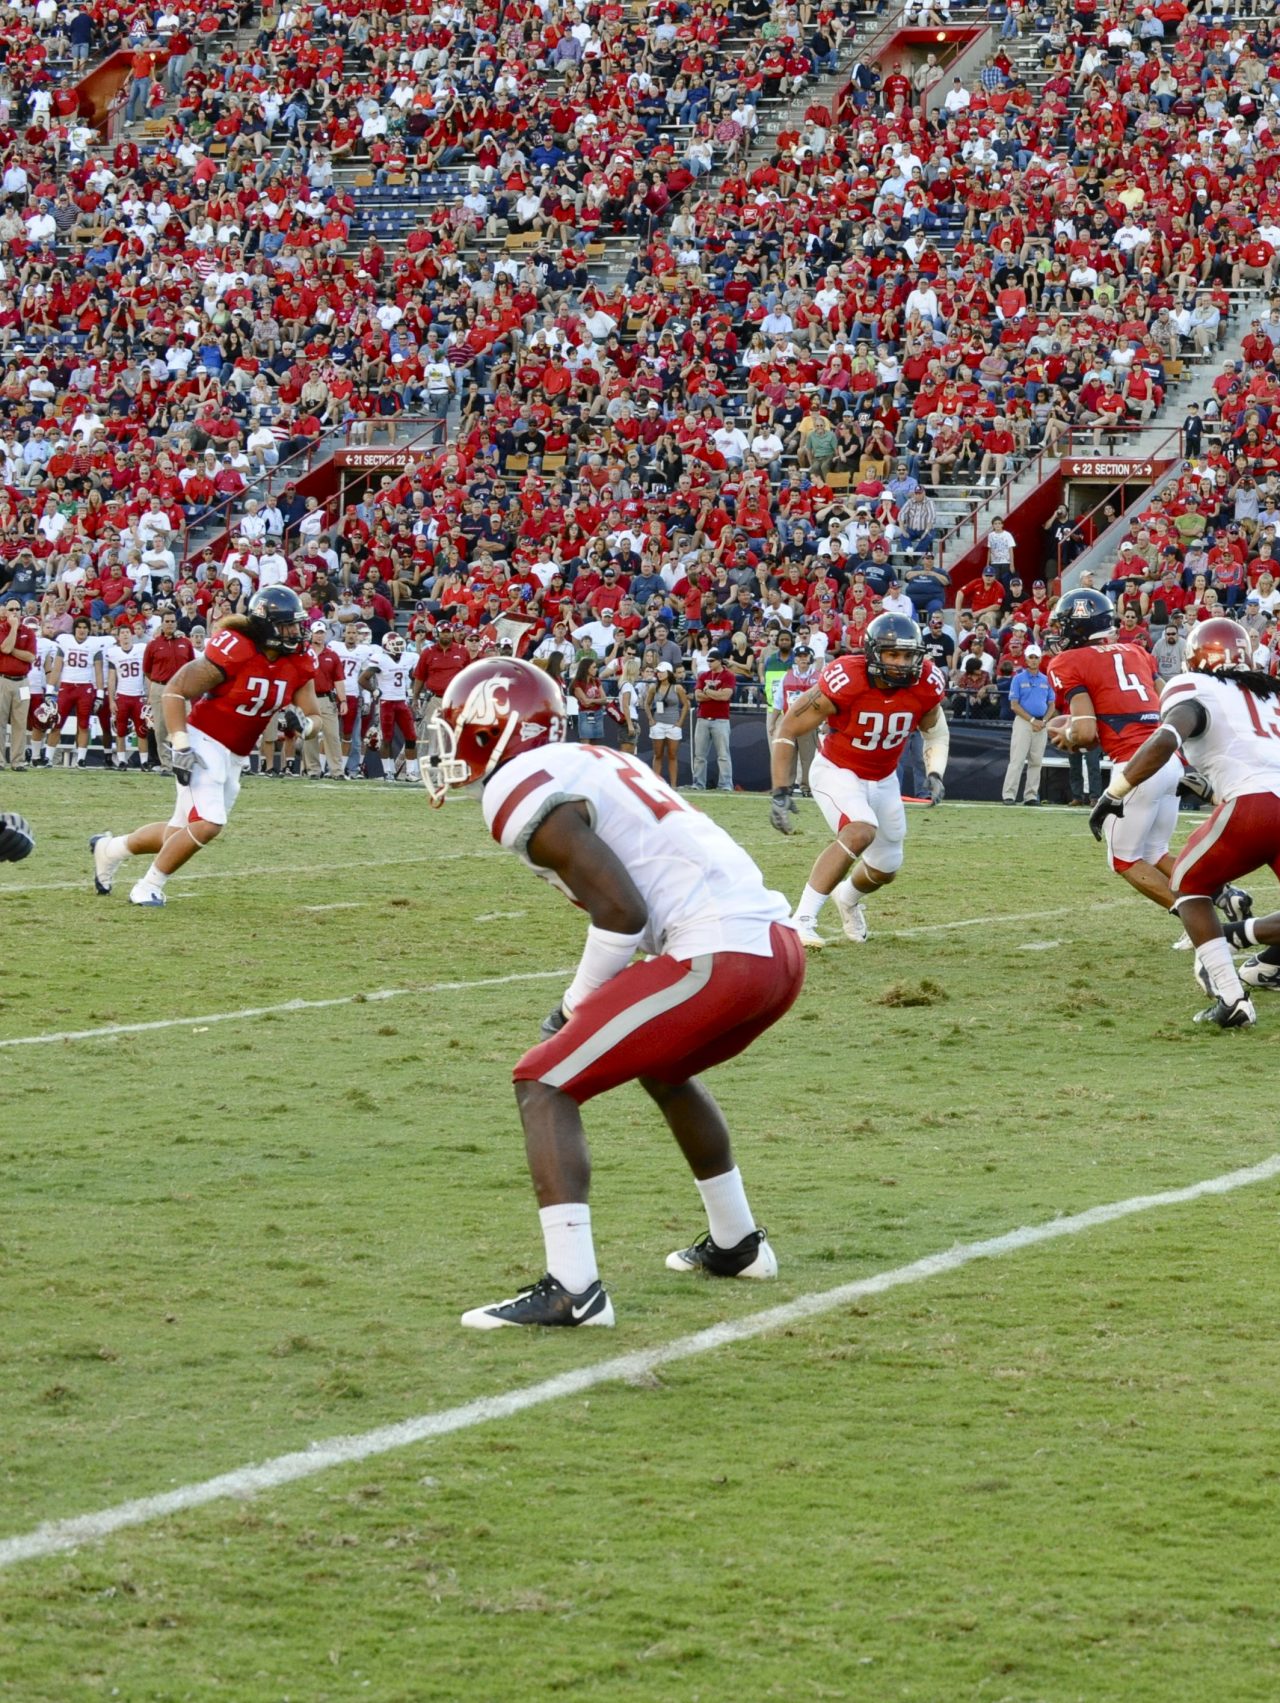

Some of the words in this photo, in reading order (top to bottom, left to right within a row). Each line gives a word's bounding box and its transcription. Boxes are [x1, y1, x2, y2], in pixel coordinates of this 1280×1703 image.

[916, 442, 924, 454] 7
[353, 455, 362, 465] 21
[363, 454, 395, 465] SECTION
[396, 454, 406, 465] 22
[1082, 463, 1093, 474] 22
[1094, 463, 1130, 475] SECTION
[210, 629, 239, 656] 31
[67, 652, 89, 669] 85
[307, 648, 320, 670] 3
[1224, 647, 1246, 663] 13
[119, 661, 140, 678] 36
[823, 663, 851, 694] 38
[1112, 652, 1150, 702] 4
[393, 671, 403, 687] 3
[1050, 670, 1064, 689] 4
[235, 677, 288, 718] 31
[851, 711, 914, 751] 38
